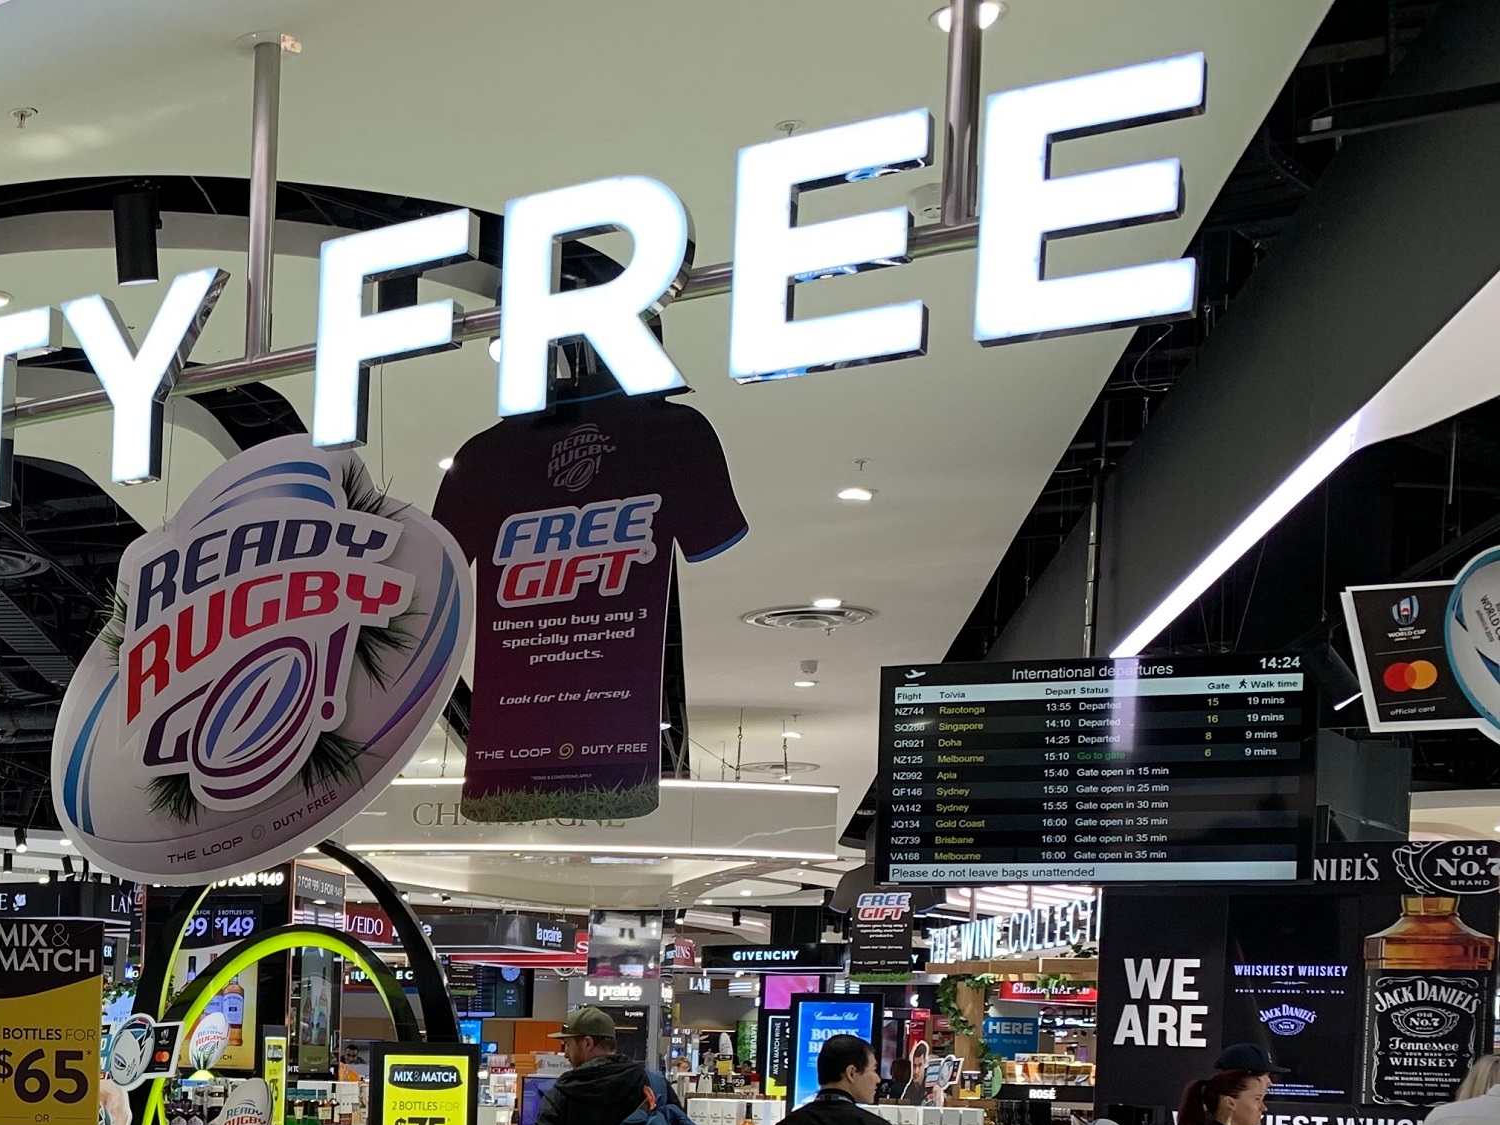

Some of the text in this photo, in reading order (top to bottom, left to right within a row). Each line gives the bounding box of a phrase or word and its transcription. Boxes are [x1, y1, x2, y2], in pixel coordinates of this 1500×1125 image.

[312, 51, 1205, 449] FREE
[500, 500, 654, 560] FREE
[135, 520, 388, 631] READY
[493, 608, 648, 632] When you buy any 3
[502, 627, 635, 650] specially marked
[126, 571, 401, 726] RUGBY
[529, 649, 604, 665] products.
[1012, 657, 1300, 680] International departures 14:24
[499, 688, 632, 706] Look for the jersey.
[897, 692, 921, 701] Flight
[940, 691, 965, 699] To/via
[1045, 688, 1076, 696] Depart
[1208, 682, 1230, 690] Gate
[143, 622, 350, 779] GO!
[939, 706, 985, 715] Rarotonga
[1390, 707, 1416, 716] official
[939, 722, 984, 732] Singapore
[894, 739, 962, 748] QR921 Doha
[475, 742, 648, 760] THE LOOP DUTY FREE
[893, 755, 984, 764] NZ125 Melbourne
[893, 772, 957, 780] NZ992 Apia
[892, 788, 970, 797] QF146 Sydney
[892, 804, 969, 813] VA142 Sydney
[891, 820, 920, 829] JQ134
[936, 820, 956, 828] Gold
[891, 836, 974, 844] NZ739 Brisbane
[890, 852, 981, 861] VA168 Melbourne
[1452, 845, 1488, 856] Old
[892, 868, 1095, 879] Please do not leave bags unattended
[1434, 858, 1500, 876] No.7
[858, 893, 911, 906] FREE
[52, 923, 70, 947] &
[925, 916, 1002, 963] THE WINE
[733, 950, 799, 961] GIVENCHY
[1234, 965, 1348, 977] WHISKIEST WHISKEY
[1124, 958, 1201, 1000] WE
[584, 981, 642, 1001] la prairie
[1374, 981, 1482, 1014] JACK DANIEL'S
[988, 1022, 1033, 1035] HERE
[1113, 1005, 1208, 1047] ARE
[1409, 1017, 1440, 1027] No.7
[3, 1028, 62, 1041] BOTTLES
[65, 1028, 95, 1041] FOR
[1389, 1037, 1459, 1051] Tennessee
[1390, 1058, 1458, 1067] WHISKEY
[1029, 1087, 1056, 1099] ROSÉ
[392, 1101, 459, 1111] 2 BOTTLES FOR
[34, 1113, 50, 1123] OR
